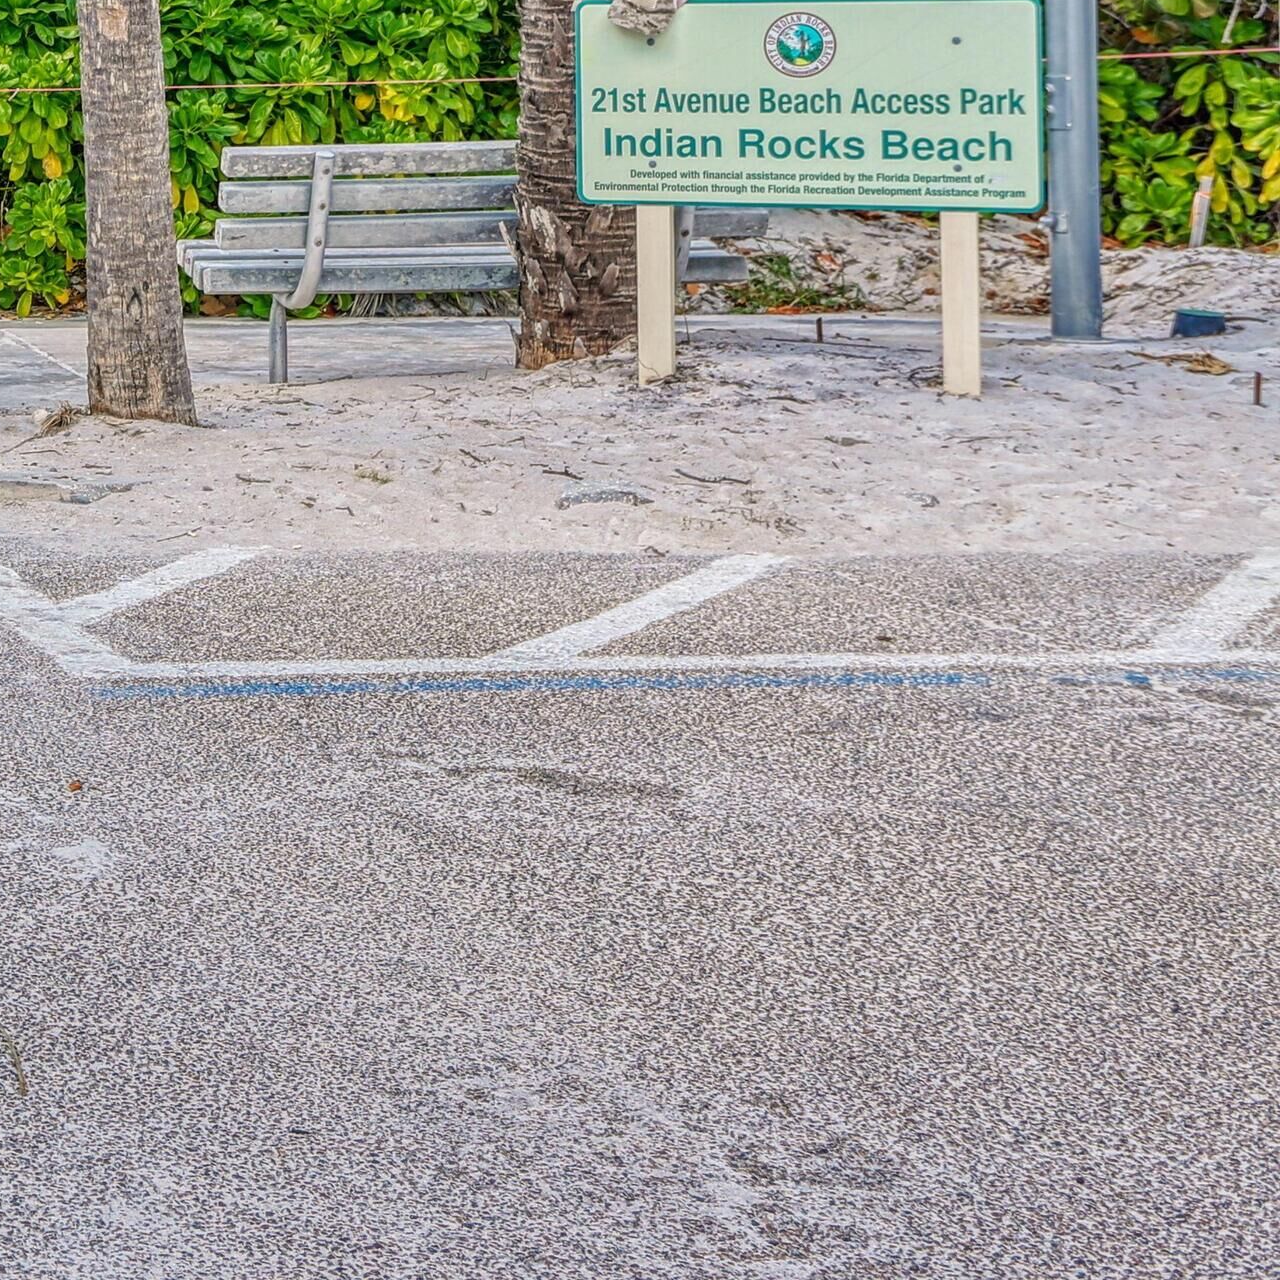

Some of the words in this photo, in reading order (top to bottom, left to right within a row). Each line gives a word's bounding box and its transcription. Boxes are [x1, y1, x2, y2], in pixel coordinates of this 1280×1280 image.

[772, 16, 802, 34] INDIAN
[805, 16, 830, 37] ROCKS
[592, 88, 646, 112] 21st
[655, 88, 750, 113] Avenue
[760, 88, 841, 113] Beach
[852, 88, 950, 114] Access
[961, 88, 1025, 114] Park
[605, 128, 722, 157] Indian
[739, 129, 864, 159] Rocks
[882, 130, 1012, 161] Beach
[630, 170, 677, 181] Developed
[680, 170, 700, 180] with
[703, 171, 743, 180] financial
[746, 172, 796, 181] assistance
[799, 172, 840, 184] provided
[844, 173, 855, 184] by
[858, 173, 874, 182] the
[876, 173, 910, 183] Florida
[913, 174, 972, 186] Department
[974, 175, 984, 184] of
[595, 183, 659, 193] Environmental
[662, 184, 708, 193] Protection
[711, 185, 747, 196] through
[751, 185, 765, 194] the
[768, 186, 800, 195] Florida
[804, 186, 855, 196] Recreation
[858, 187, 922, 199] Development
[925, 188, 979, 197] Assistance
[982, 189, 1026, 200] Program
